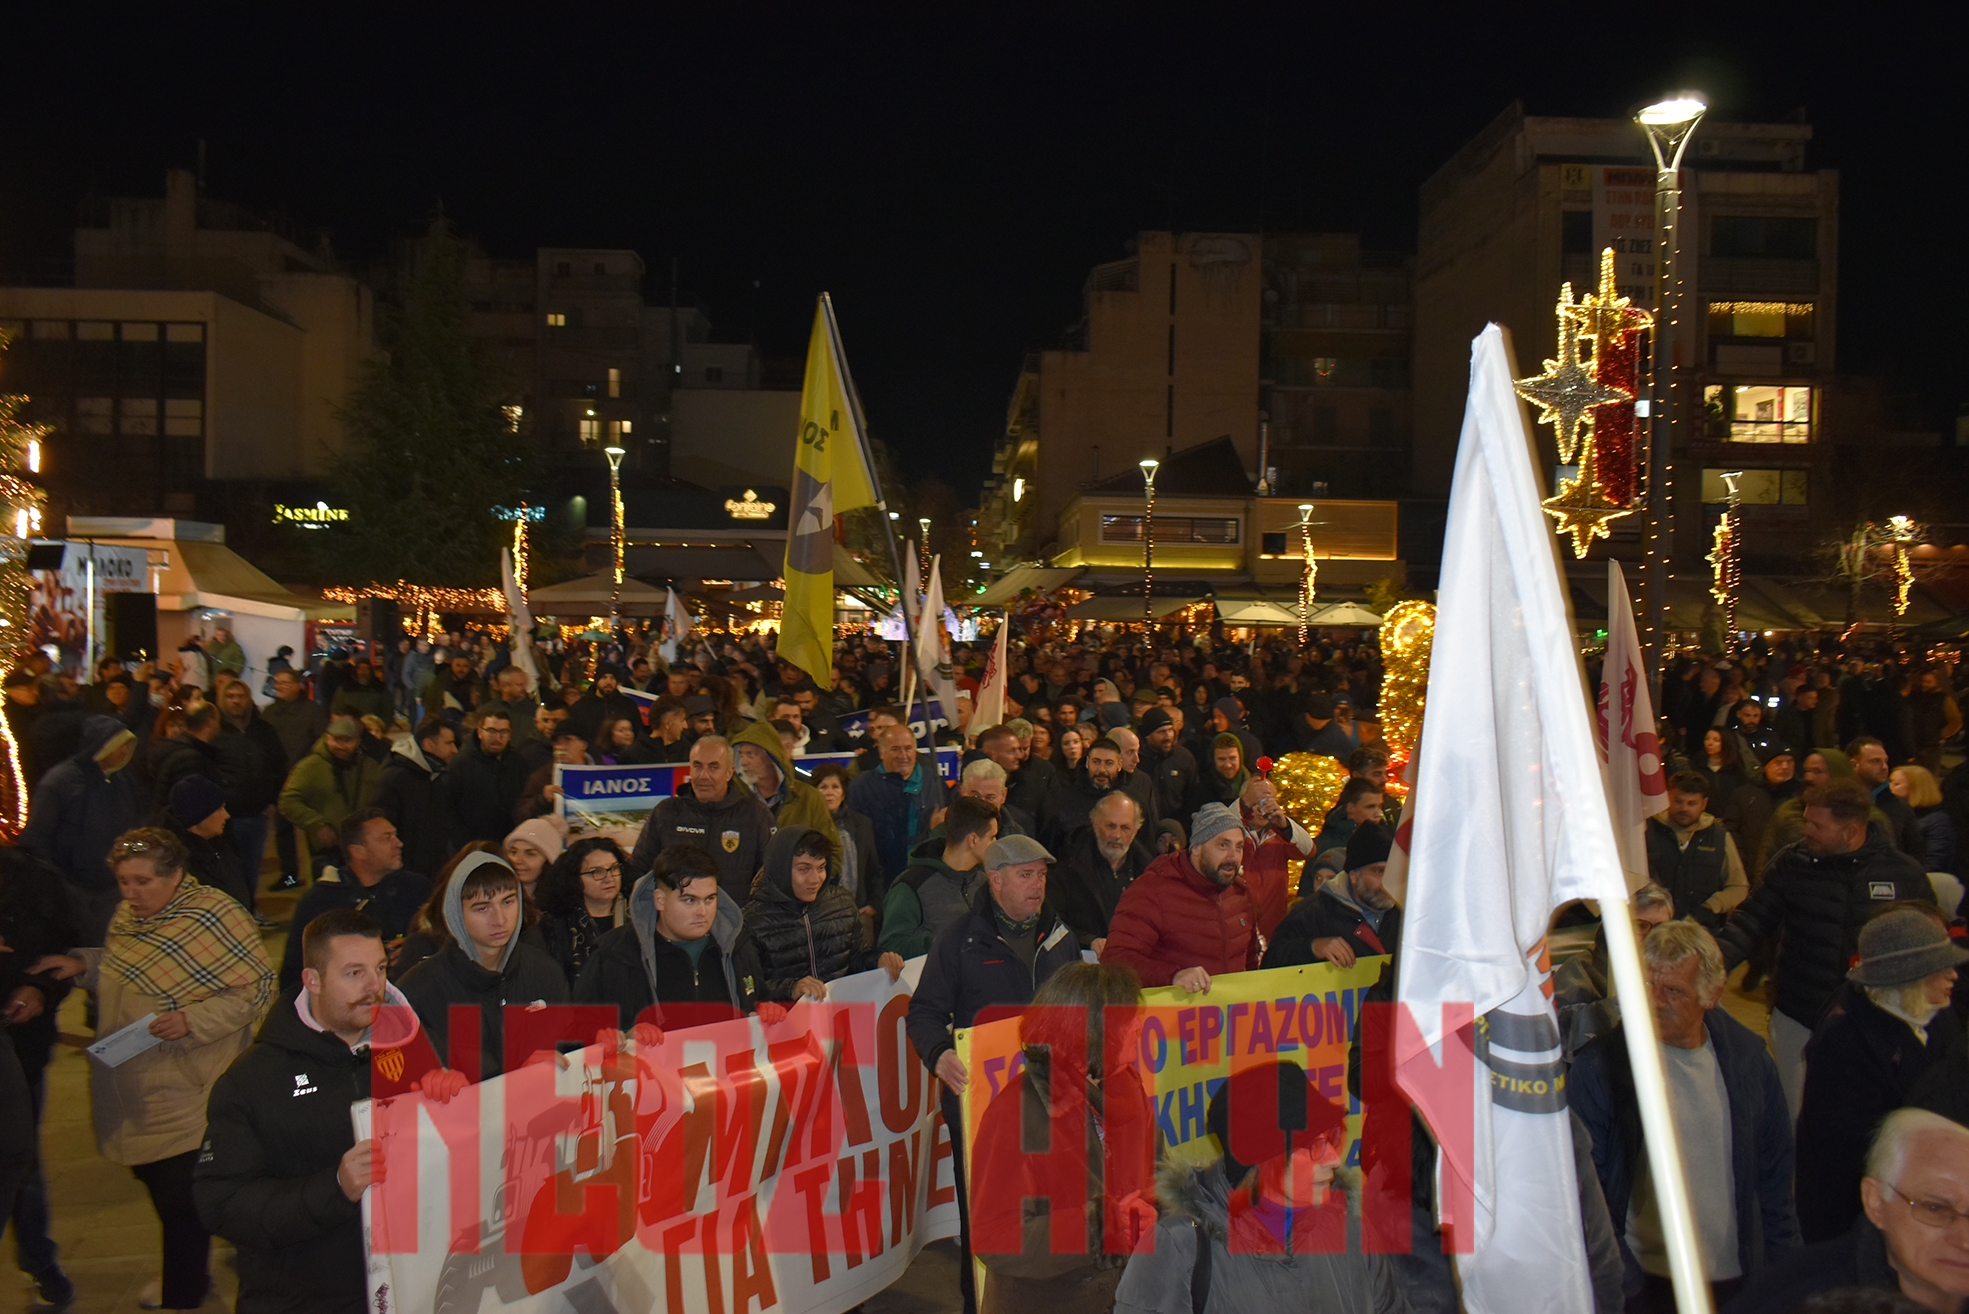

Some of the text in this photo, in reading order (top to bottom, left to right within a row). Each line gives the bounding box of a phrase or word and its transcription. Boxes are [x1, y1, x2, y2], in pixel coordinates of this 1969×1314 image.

[583, 777, 652, 795] ΙΑΝΟΣ
[292, 1086, 319, 1098] Zeus
[678, 993, 946, 1216] ΜΠΛΟ
